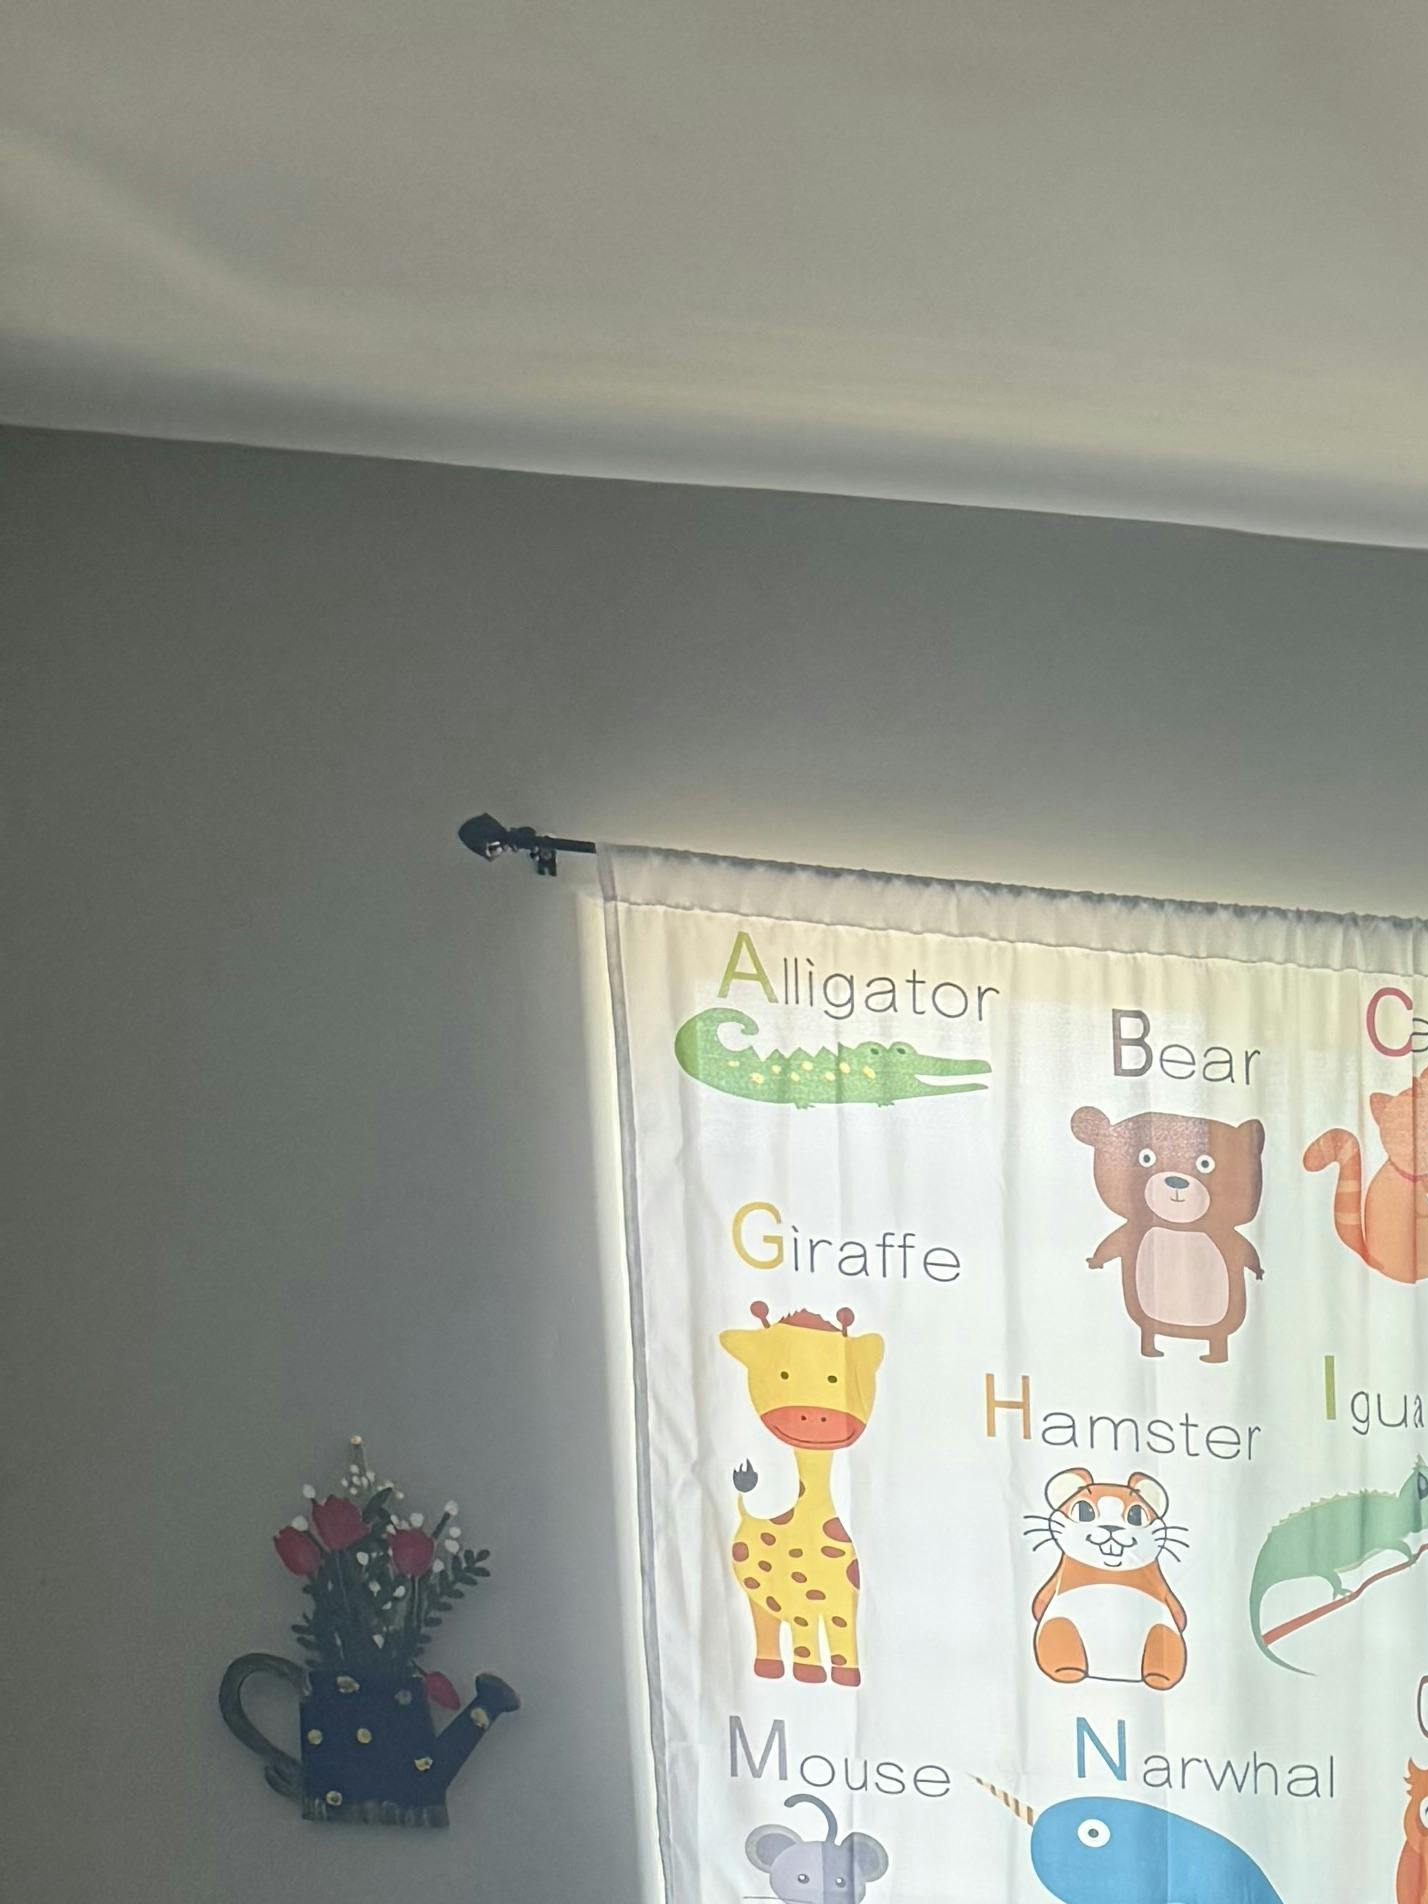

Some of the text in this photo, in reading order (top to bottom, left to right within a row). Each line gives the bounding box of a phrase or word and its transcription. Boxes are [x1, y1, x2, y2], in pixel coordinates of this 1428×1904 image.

[717, 931, 1000, 1020] Alligator
[1113, 1008, 1262, 1086] Bear
[730, 1200, 963, 1283] Giraffe
[985, 1372, 1262, 1462] Hamster
[728, 1715, 952, 1799] Mouse
[1075, 1716, 1337, 1800] Narwhal
